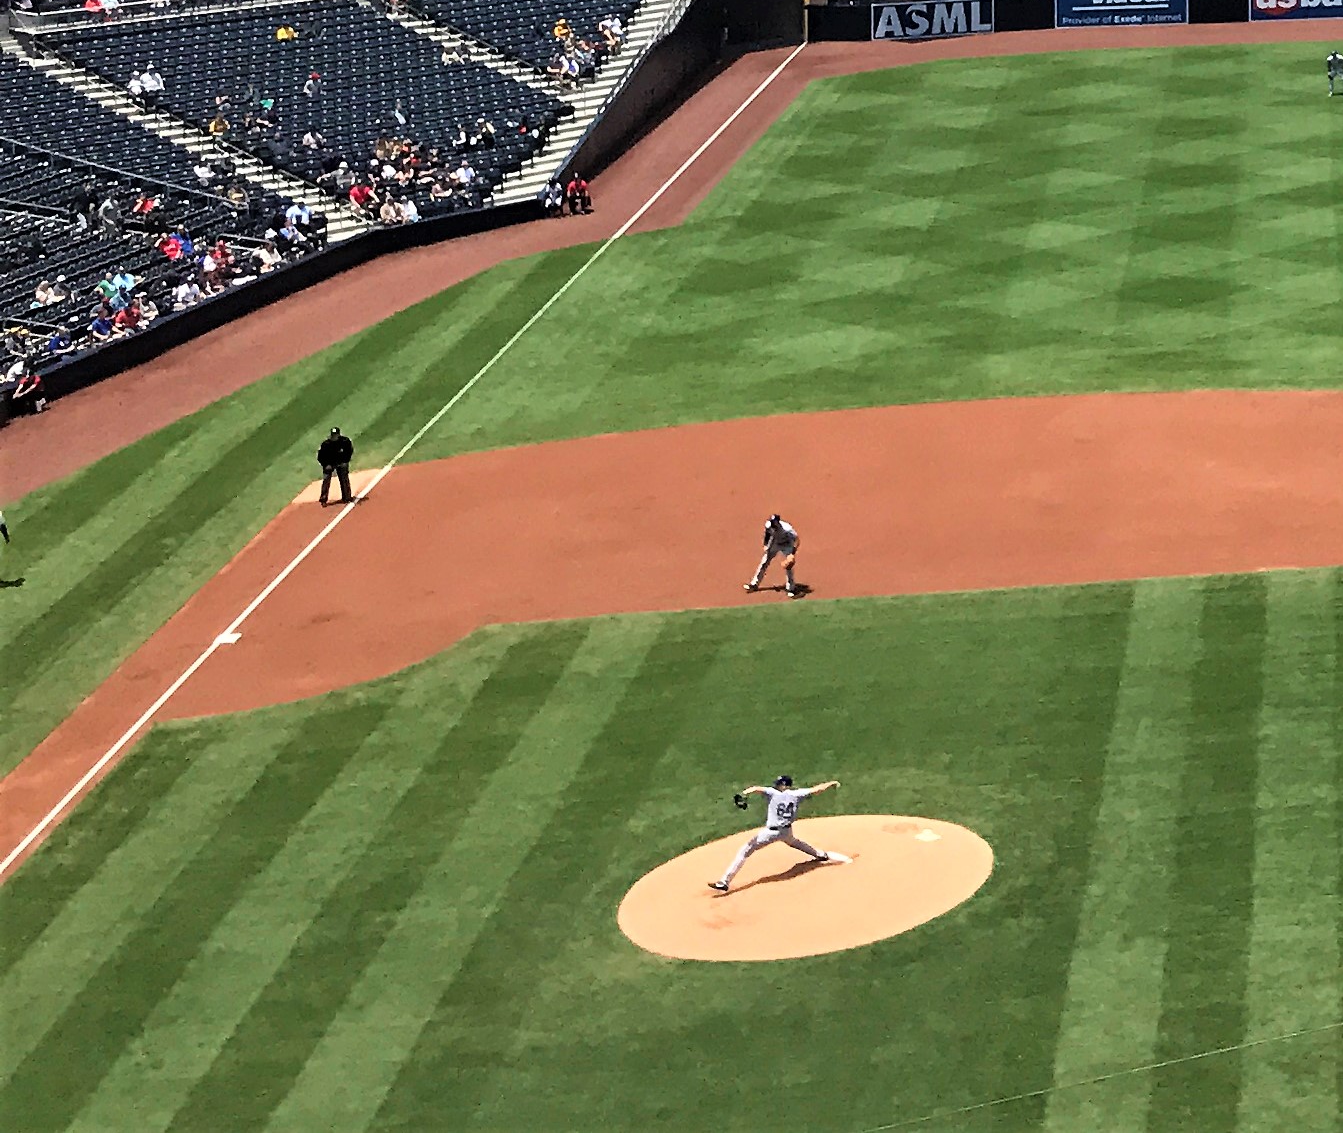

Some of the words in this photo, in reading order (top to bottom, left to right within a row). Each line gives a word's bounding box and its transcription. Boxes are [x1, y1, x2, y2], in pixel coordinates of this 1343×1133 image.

[875, 0, 993, 38] ASML
[1062, 16, 1099, 24] Provider
[1103, 15, 1112, 23] of
[1147, 13, 1182, 22] Internet
